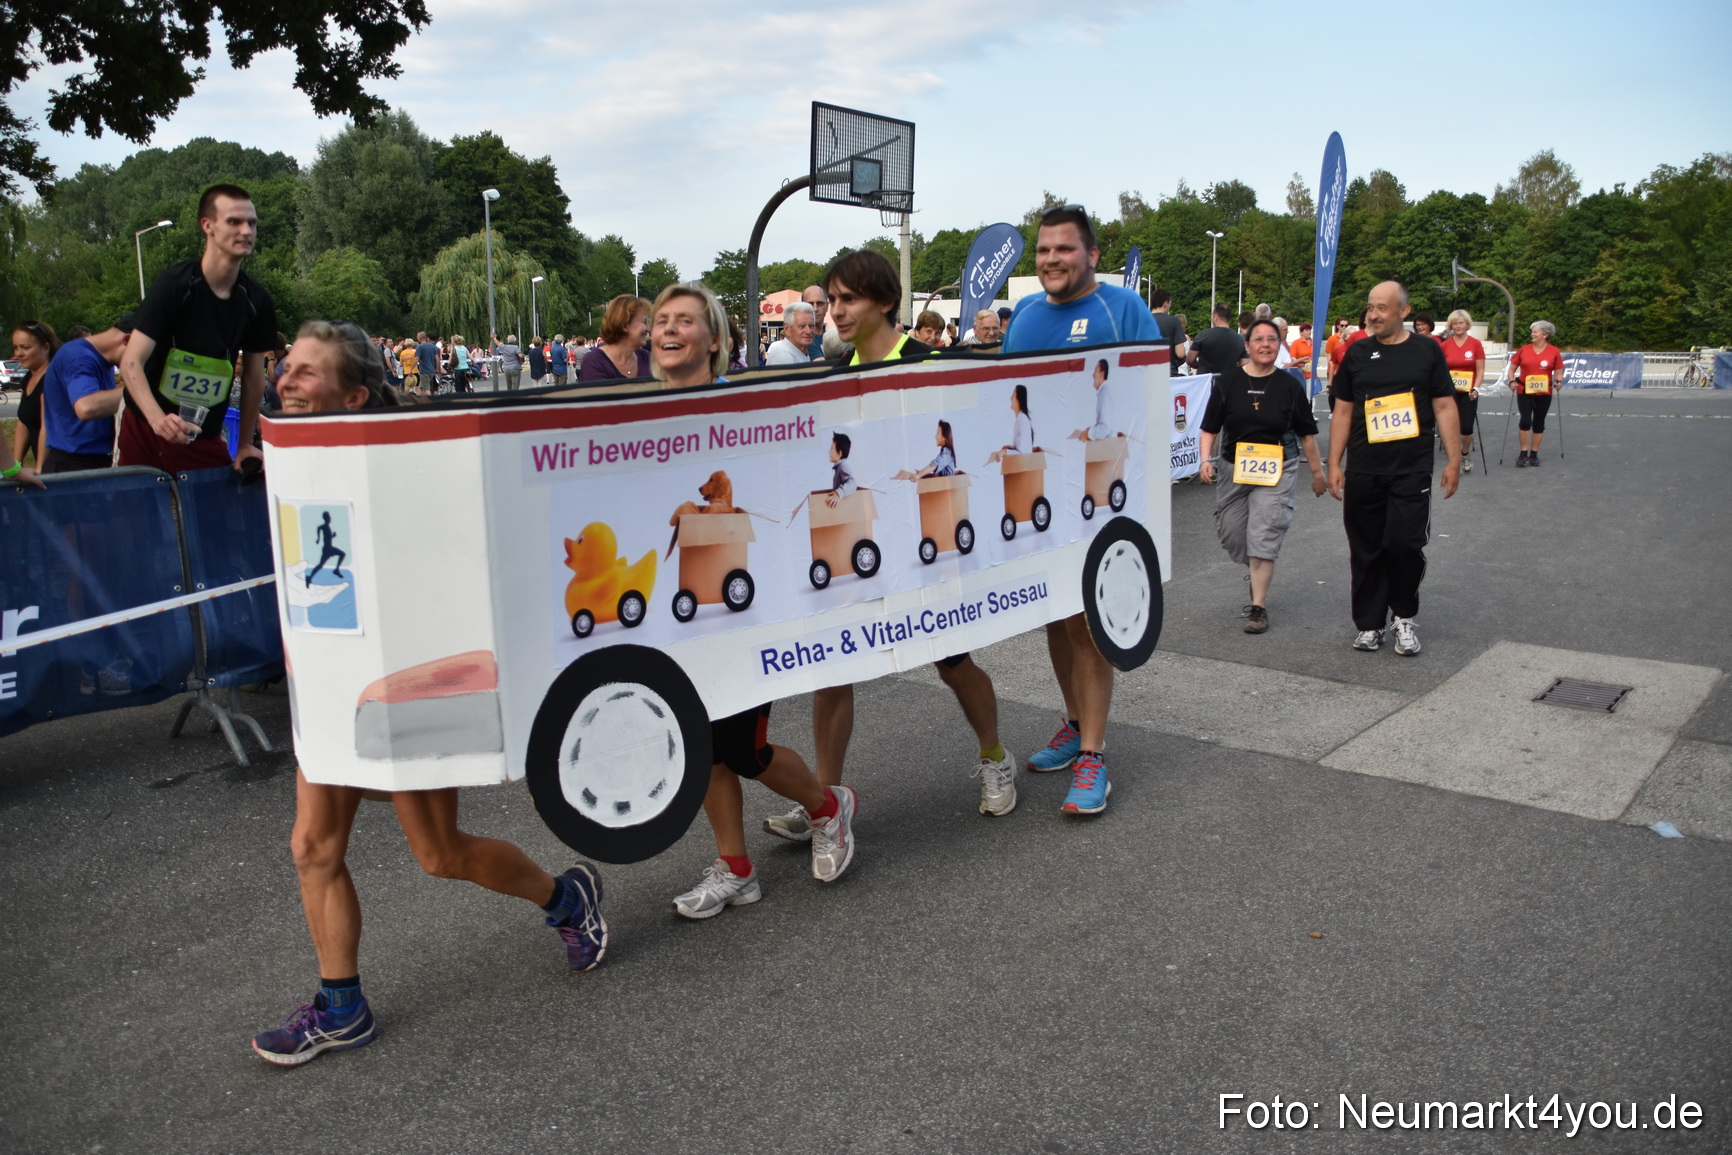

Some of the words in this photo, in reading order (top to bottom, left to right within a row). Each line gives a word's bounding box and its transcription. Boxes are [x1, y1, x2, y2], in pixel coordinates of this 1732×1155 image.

[978, 236, 1012, 289] Fischer
[989, 247, 1016, 290] AUTOMOBILE
[170, 372, 222, 397] 1231
[1563, 367, 1619, 378] Fischer
[1371, 410, 1412, 430] 1184
[532, 441, 579, 472] Wir
[588, 433, 700, 465] bewegen
[708, 415, 815, 450] Neumarkt
[1240, 459, 1277, 475] 1243
[760, 641, 834, 675] Reha-
[840, 629, 858, 655] &
[861, 601, 983, 648] Vital-Center
[988, 582, 1048, 614] Sossau
